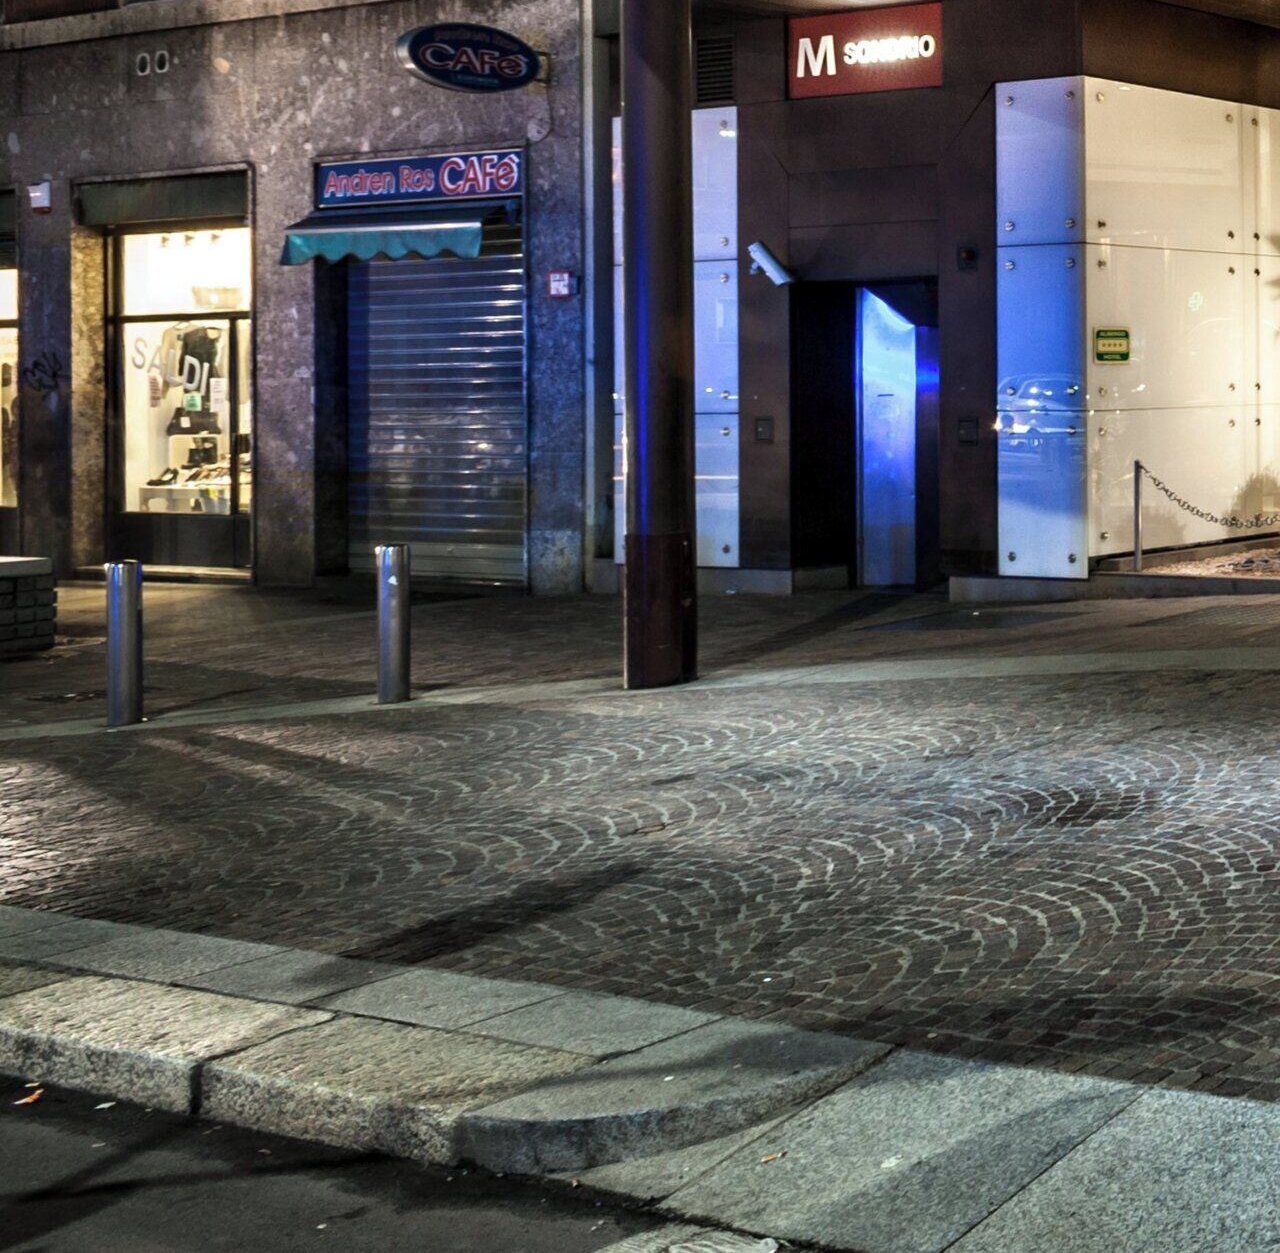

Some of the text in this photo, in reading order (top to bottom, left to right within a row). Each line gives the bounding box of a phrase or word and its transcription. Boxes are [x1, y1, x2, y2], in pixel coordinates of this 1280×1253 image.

[797, 34, 936, 78] M SONDRIO
[323, 170, 397, 198] Andren
[399, 165, 436, 193] Ros
[131, 337, 210, 397] SALDI
